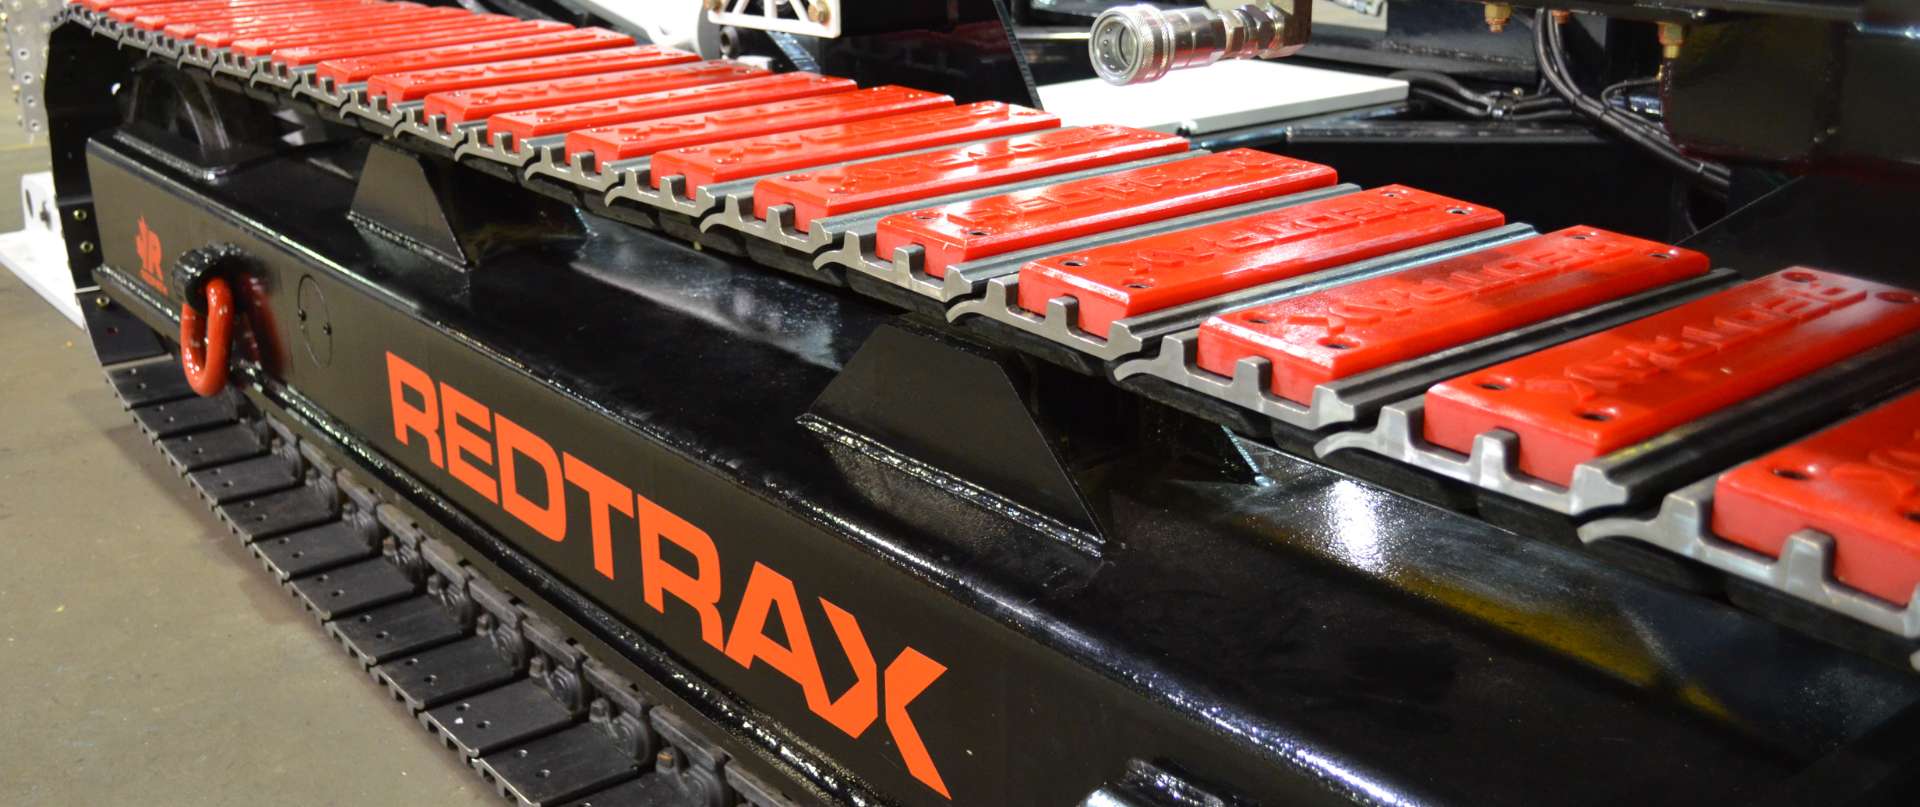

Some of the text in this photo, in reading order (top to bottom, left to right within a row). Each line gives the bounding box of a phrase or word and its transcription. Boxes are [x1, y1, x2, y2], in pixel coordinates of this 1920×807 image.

[1100, 198, 1433, 274] REDTRAX
[1288, 242, 1634, 337] REDTRAX
[1526, 284, 1867, 403] REDTRAX
[386, 351, 951, 800] REDTRAX
